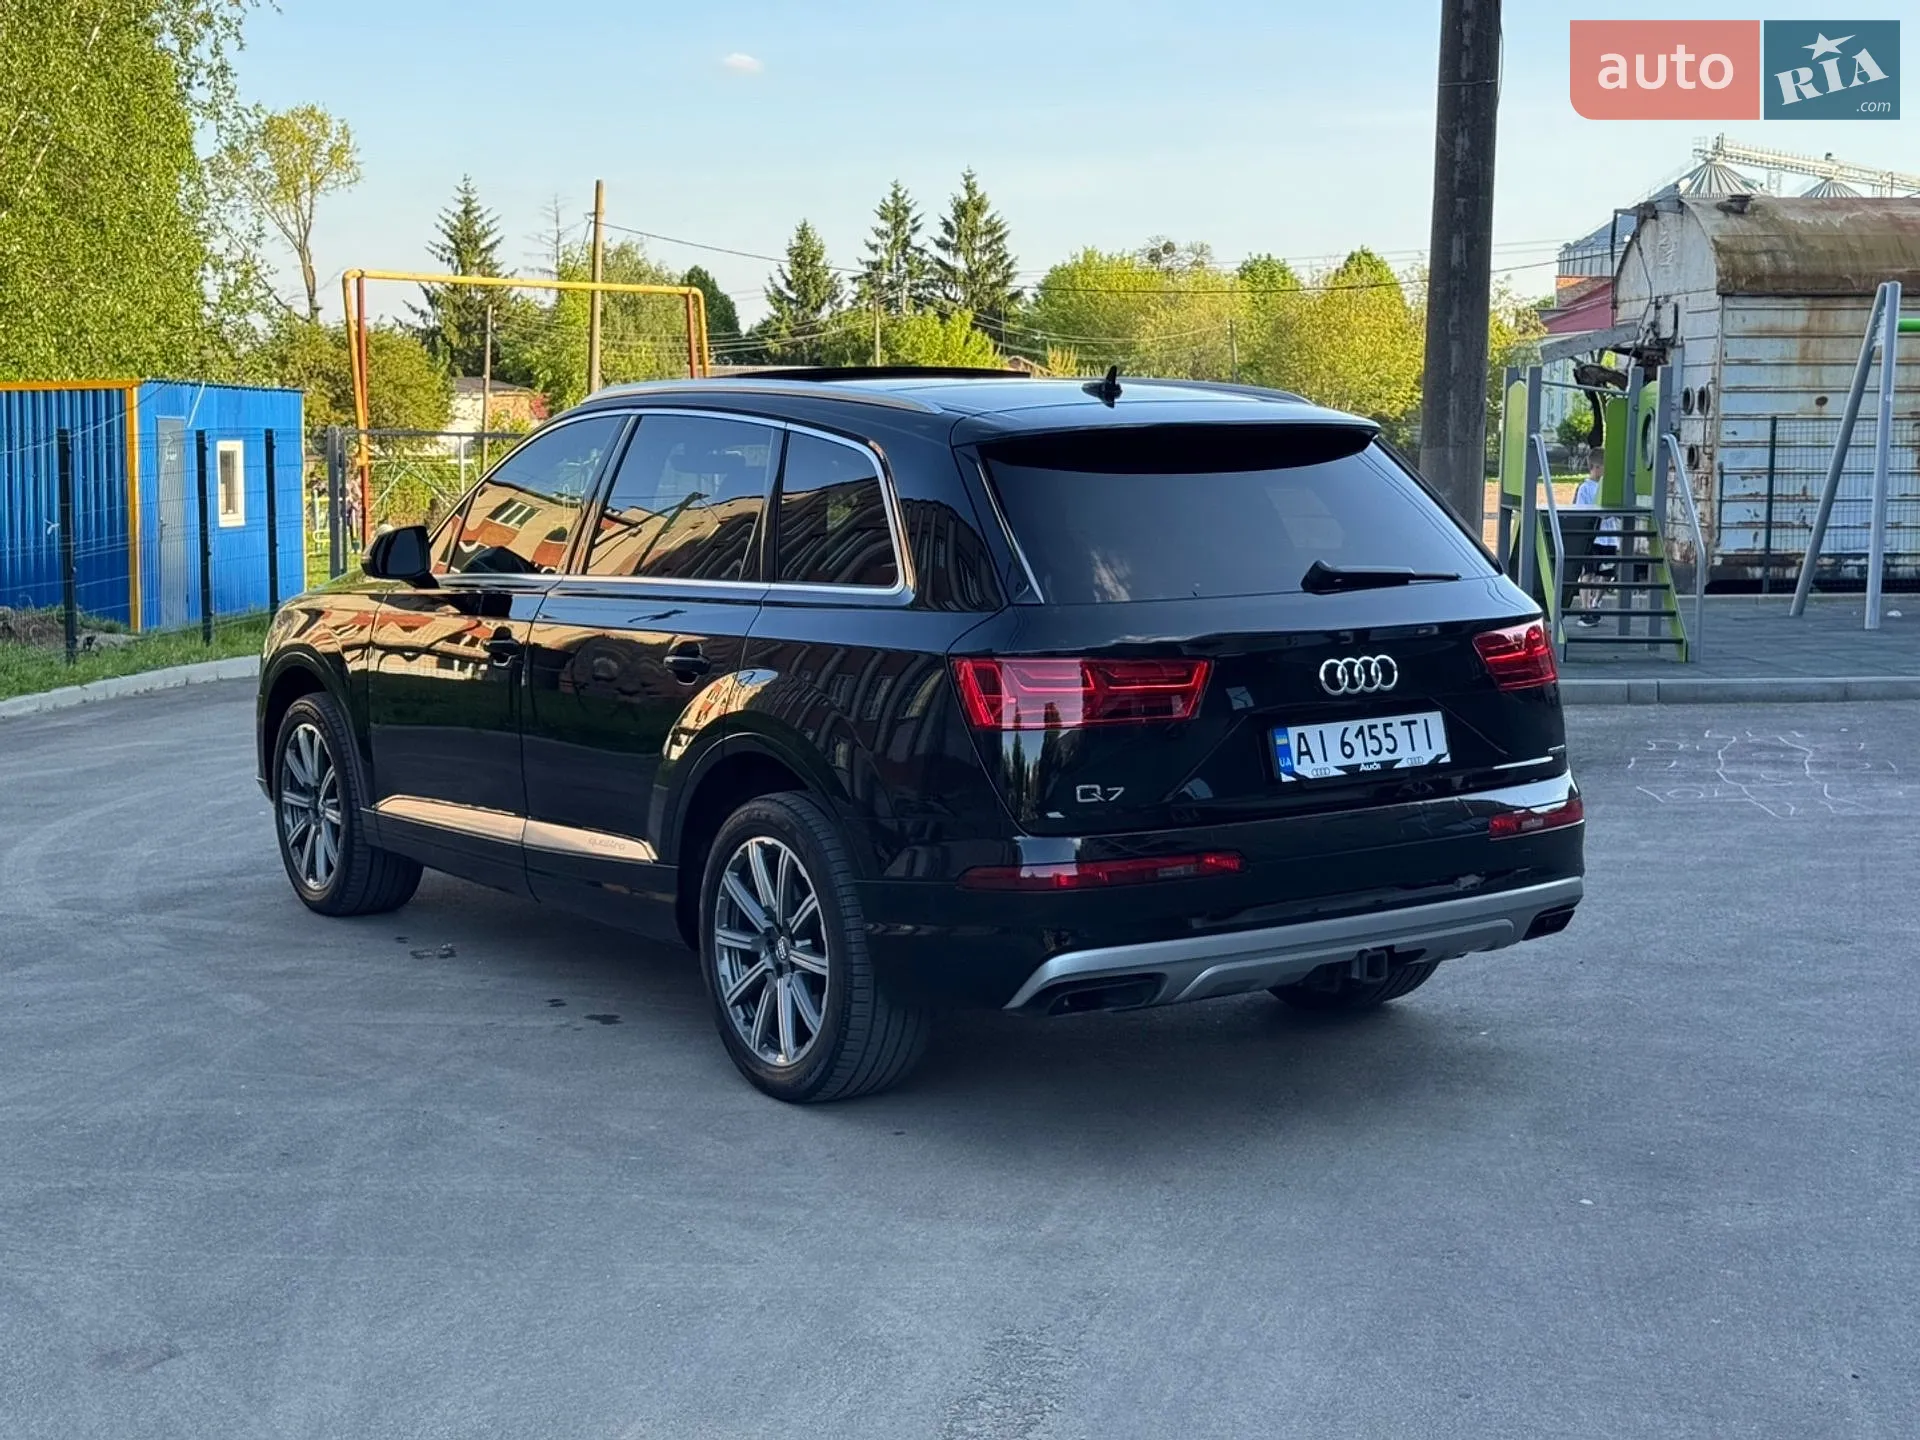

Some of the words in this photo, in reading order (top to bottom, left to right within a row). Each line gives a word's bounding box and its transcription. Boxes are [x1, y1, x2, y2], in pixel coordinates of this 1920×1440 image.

[1296, 729, 1329, 766] AI
[1339, 722, 1398, 760] 6155
[1400, 718, 1433, 752] TI
[1279, 757, 1292, 768] UA
[1359, 762, 1382, 772] Audi
[1076, 784, 1125, 803] Q7
